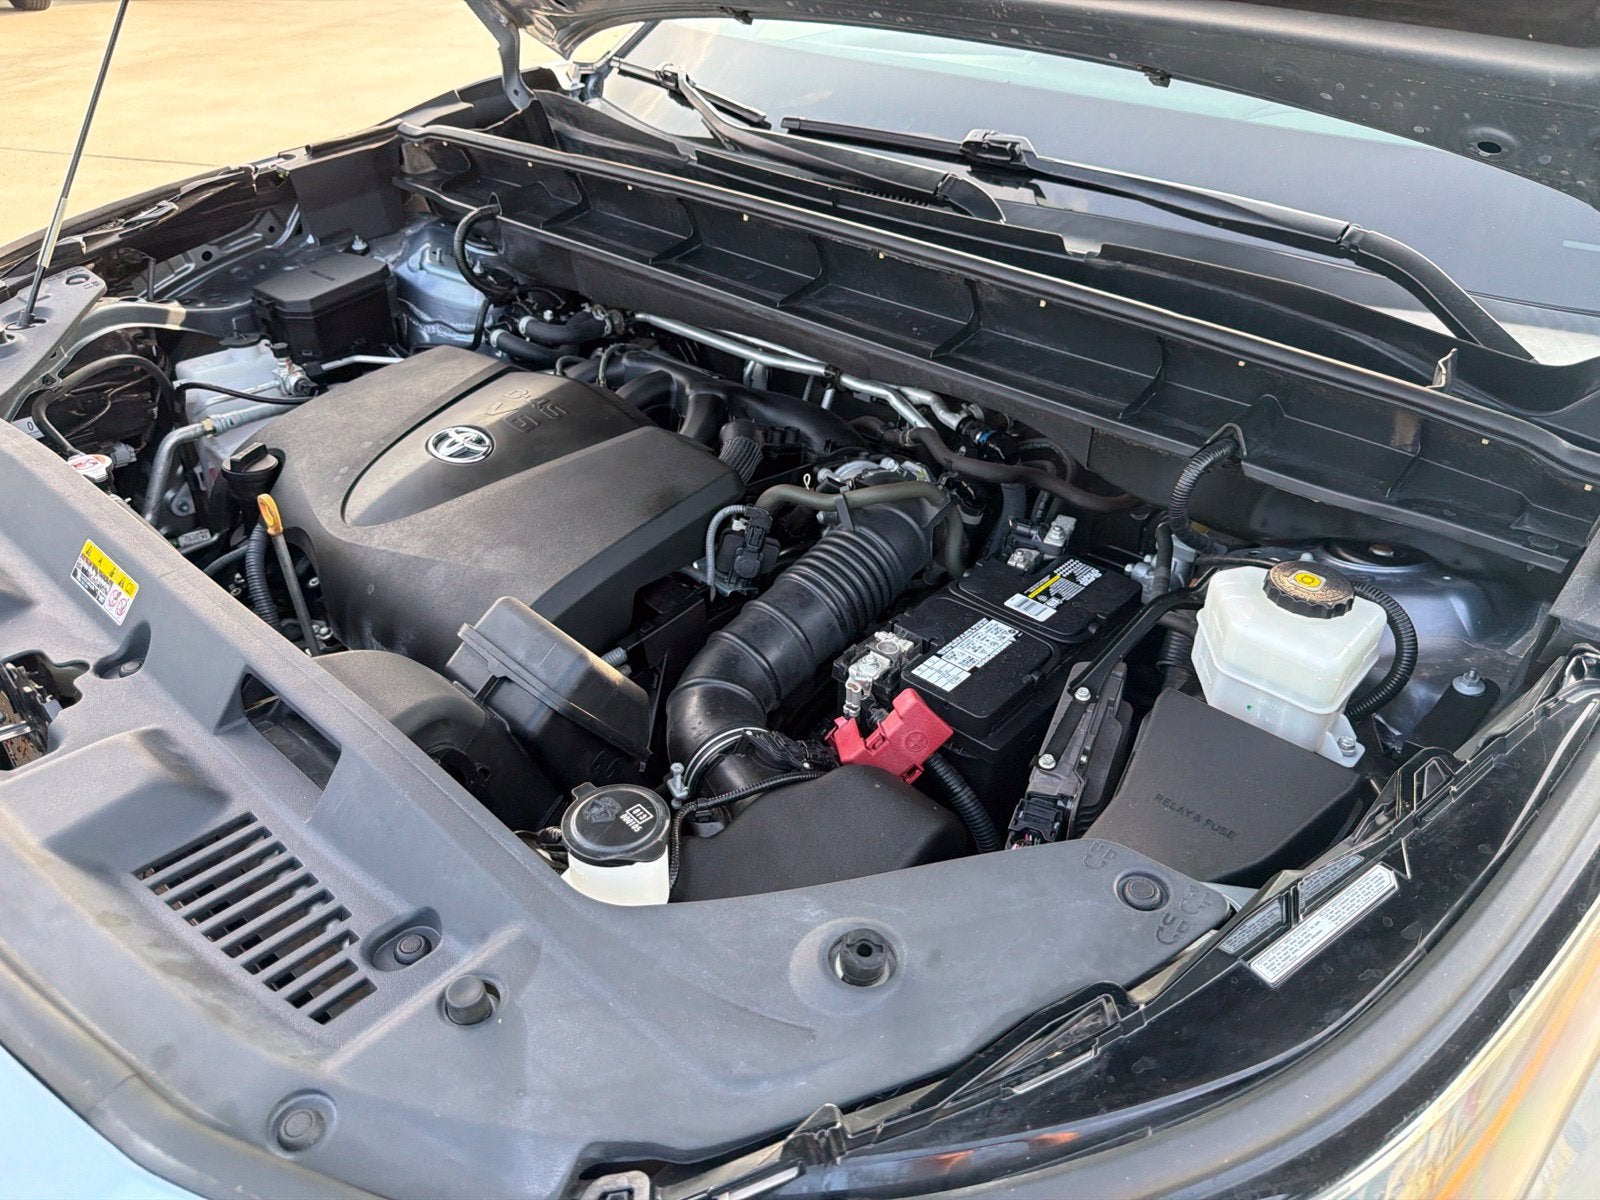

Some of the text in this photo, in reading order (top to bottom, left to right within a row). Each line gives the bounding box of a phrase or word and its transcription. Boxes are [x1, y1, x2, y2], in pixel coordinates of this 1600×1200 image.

[486, 402, 540, 433] V6
[1154, 793, 1194, 817] RELAY
[1203, 818, 1238, 840] FUSE
